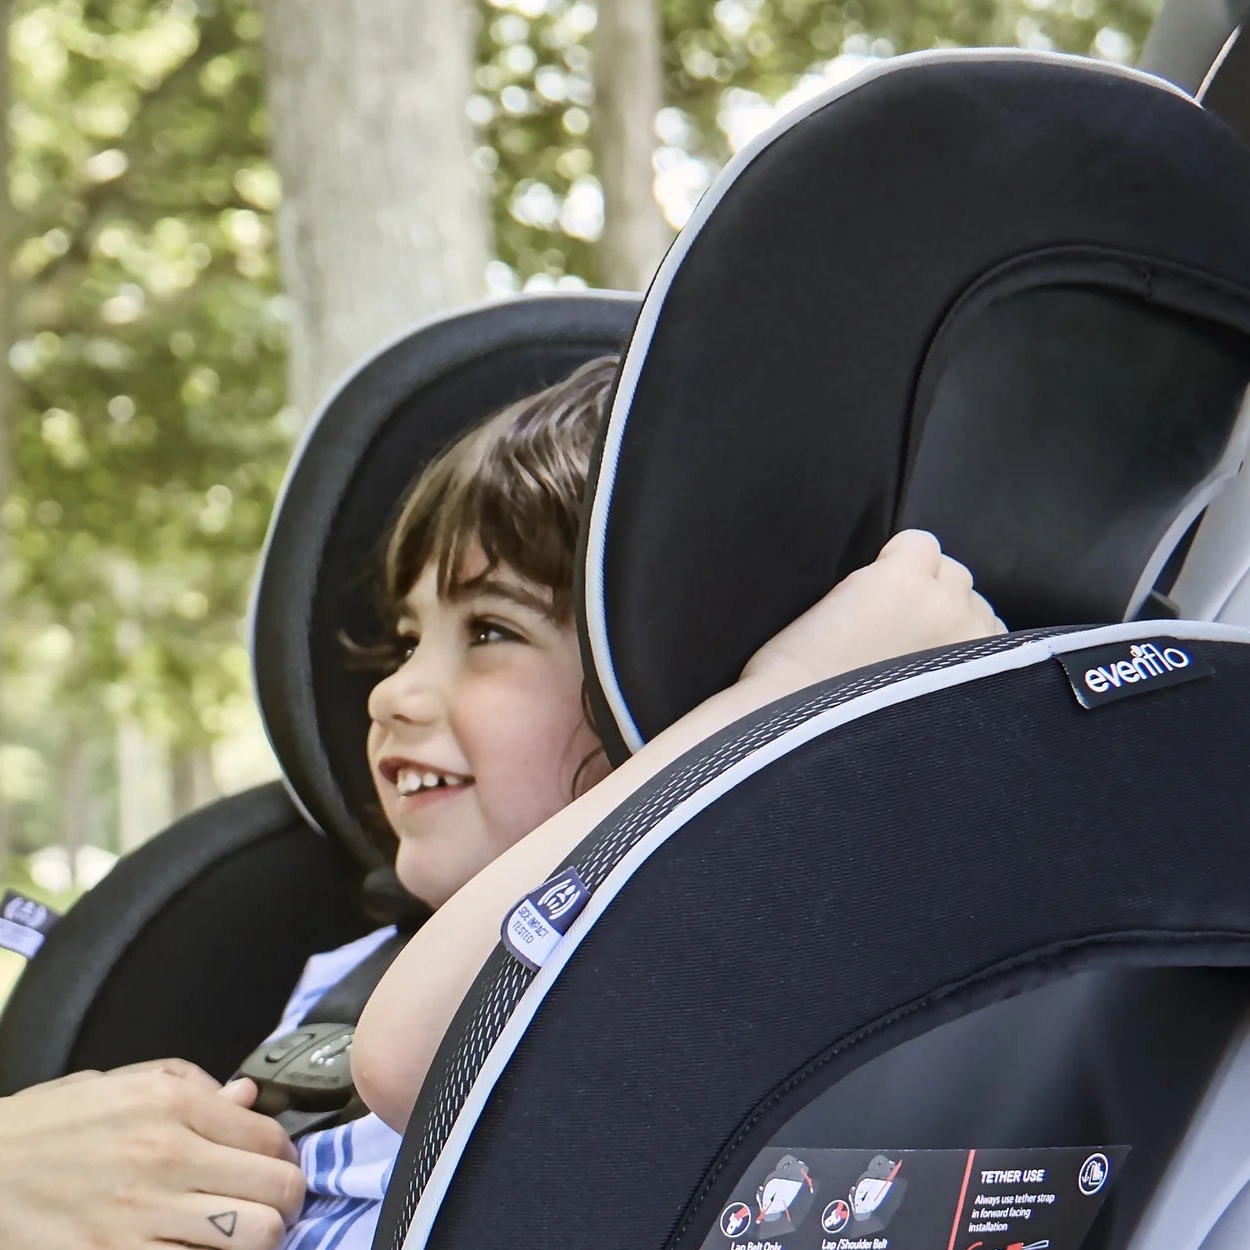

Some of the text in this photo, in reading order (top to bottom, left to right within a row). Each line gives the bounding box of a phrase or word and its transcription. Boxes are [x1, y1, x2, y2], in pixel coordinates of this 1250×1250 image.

[1084, 643, 1190, 692] evenflo
[517, 906, 549, 940] SIDE IMPACT
[512, 922, 534, 944] TESTED
[981, 1169, 1044, 1183] TETHER USE
[968, 1221, 1007, 1232] installation
[872, 1238, 887, 1249] Belt
